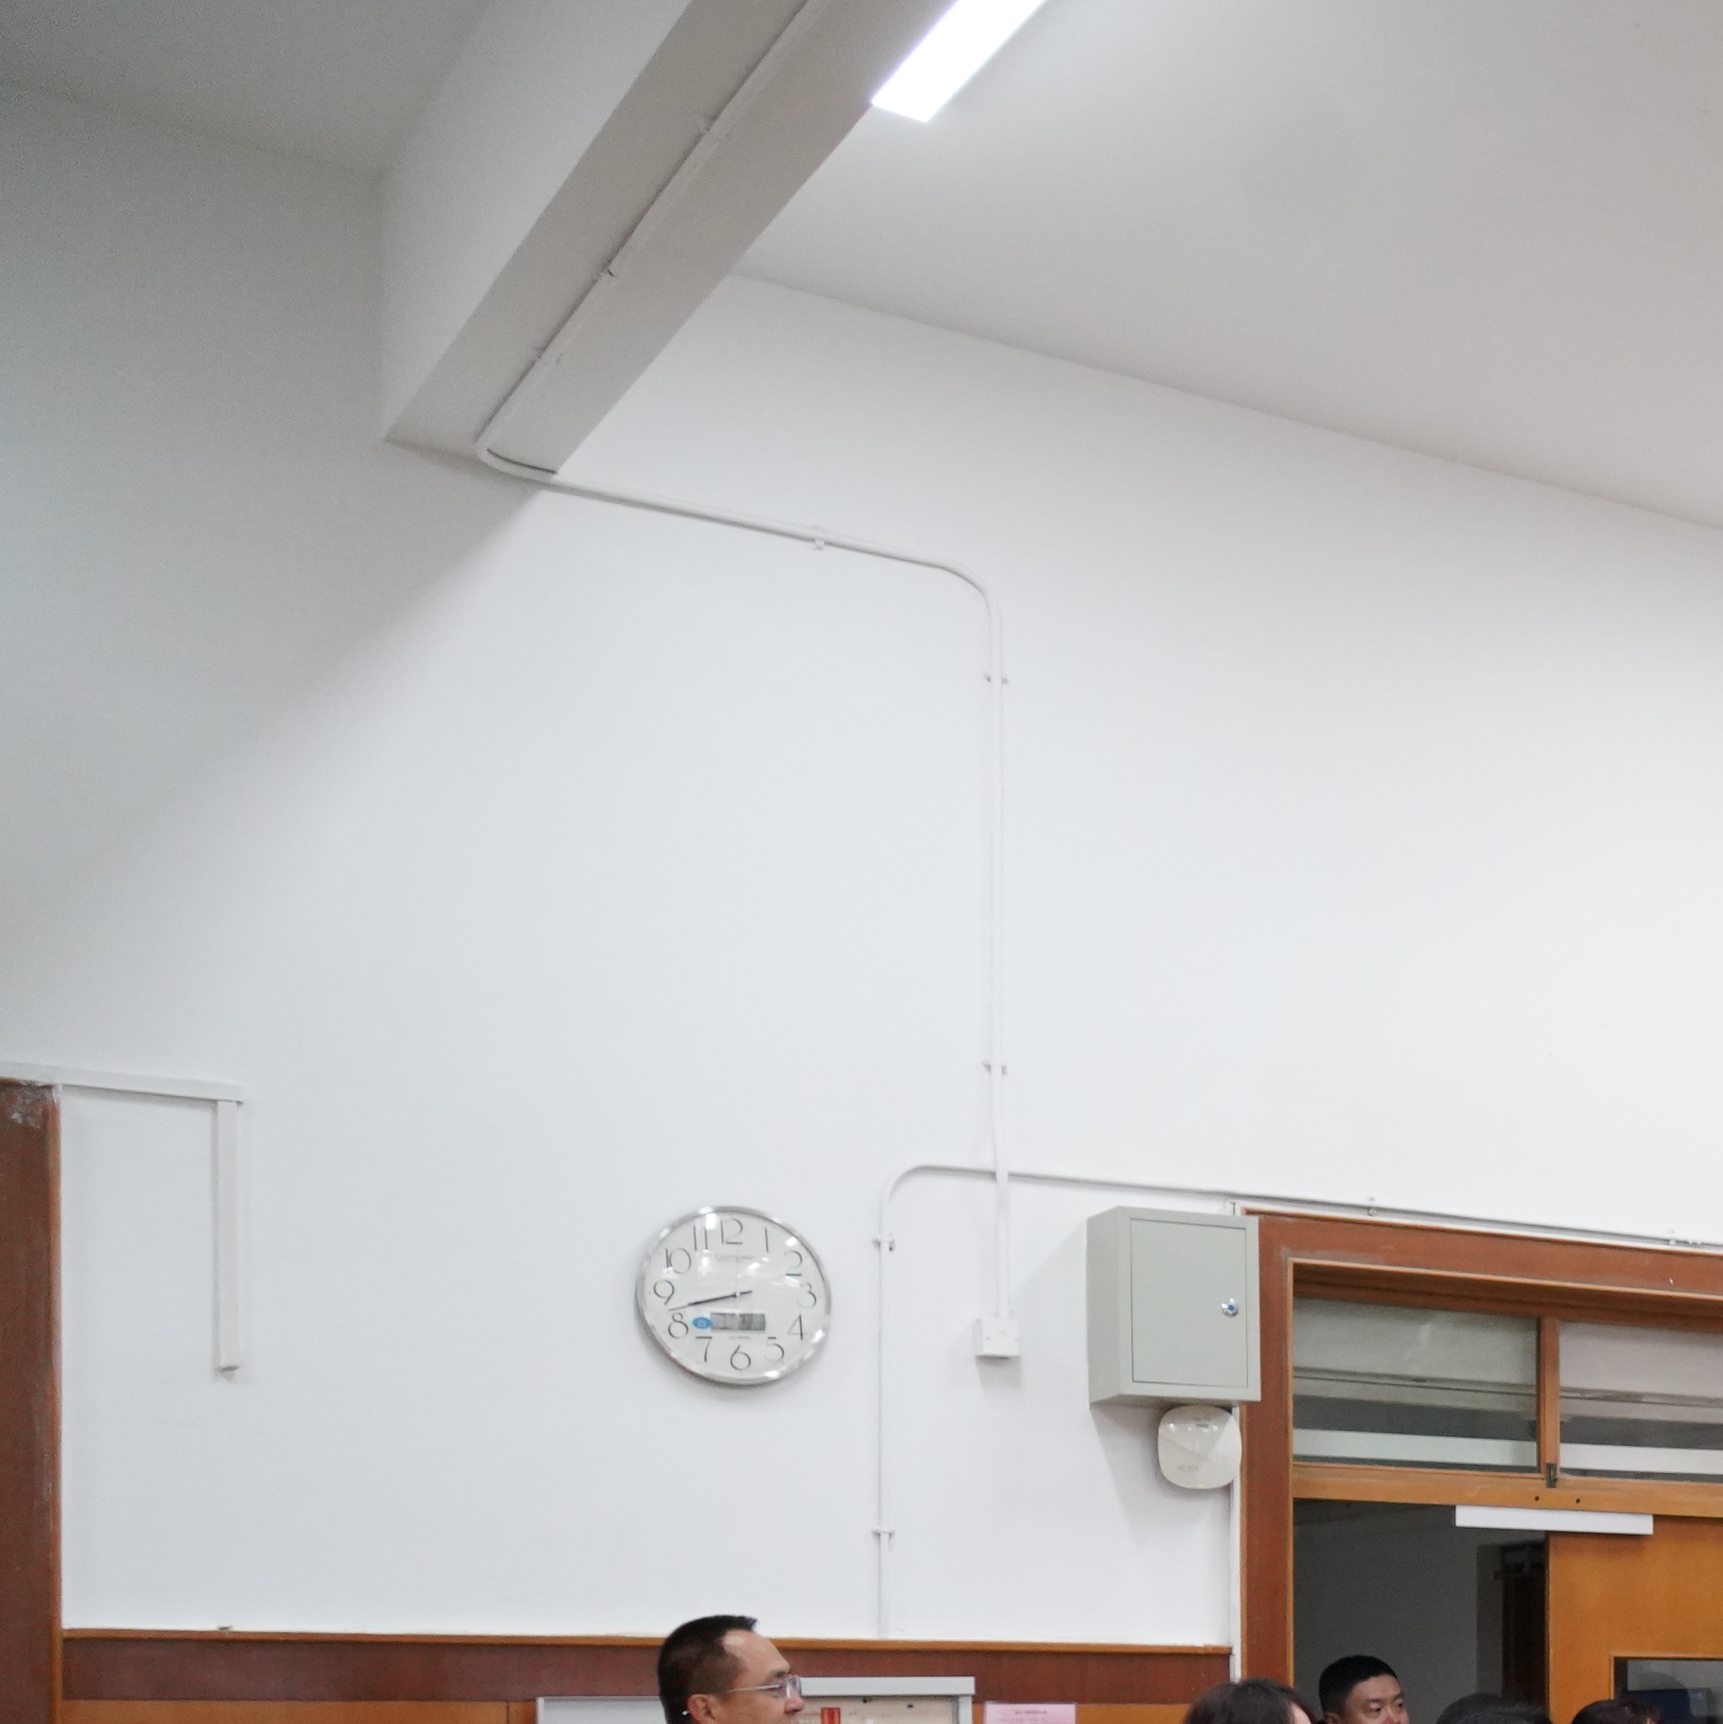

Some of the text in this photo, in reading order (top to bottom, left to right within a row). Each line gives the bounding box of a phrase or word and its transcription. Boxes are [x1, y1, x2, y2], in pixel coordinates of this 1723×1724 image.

[720, 1218, 744, 1245] 12
[665, 1246, 692, 1275] 10
[784, 1250, 803, 1277] 2
[653, 1278, 675, 1306] 9
[796, 1281, 817, 1309] 3
[667, 1312, 689, 1339] 8
[786, 1312, 812, 1341] 4
[695, 1335, 713, 1363] 7
[730, 1344, 752, 1371] 6
